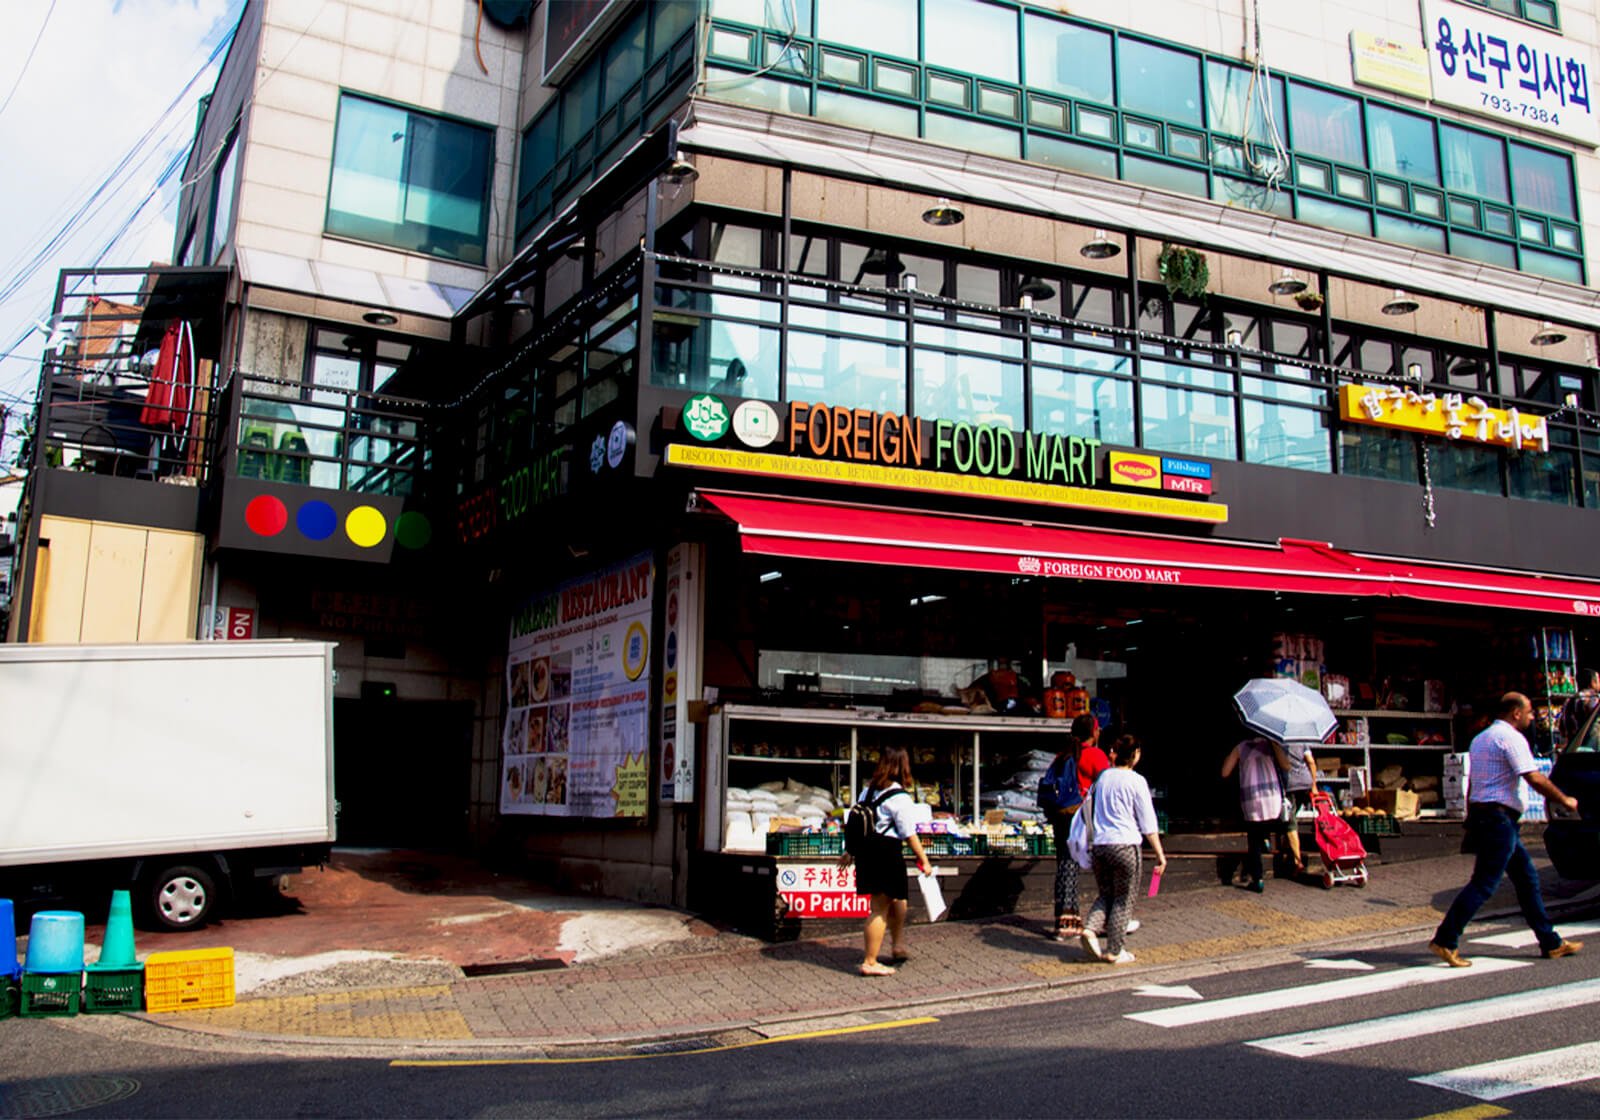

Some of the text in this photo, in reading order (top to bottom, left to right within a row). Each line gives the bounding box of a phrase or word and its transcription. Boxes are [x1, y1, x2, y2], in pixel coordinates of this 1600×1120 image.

[1480, 92, 1560, 126] 793-7384
[789, 400, 1102, 486] FOREIGN FOOD MART
[680, 447, 733, 467] DISCOUNT
[736, 451, 764, 468] SHOP
[770, 454, 833, 477] WHOLESALE
[847, 464, 882, 481] RETAIL
[883, 469, 911, 484] FOOD
[912, 472, 965, 490] SPECIALIST
[1171, 478, 1204, 493] MTR
[1044, 561, 1181, 583] FOREIGN FOOD MART
[561, 564, 650, 623] RESTAURANT
